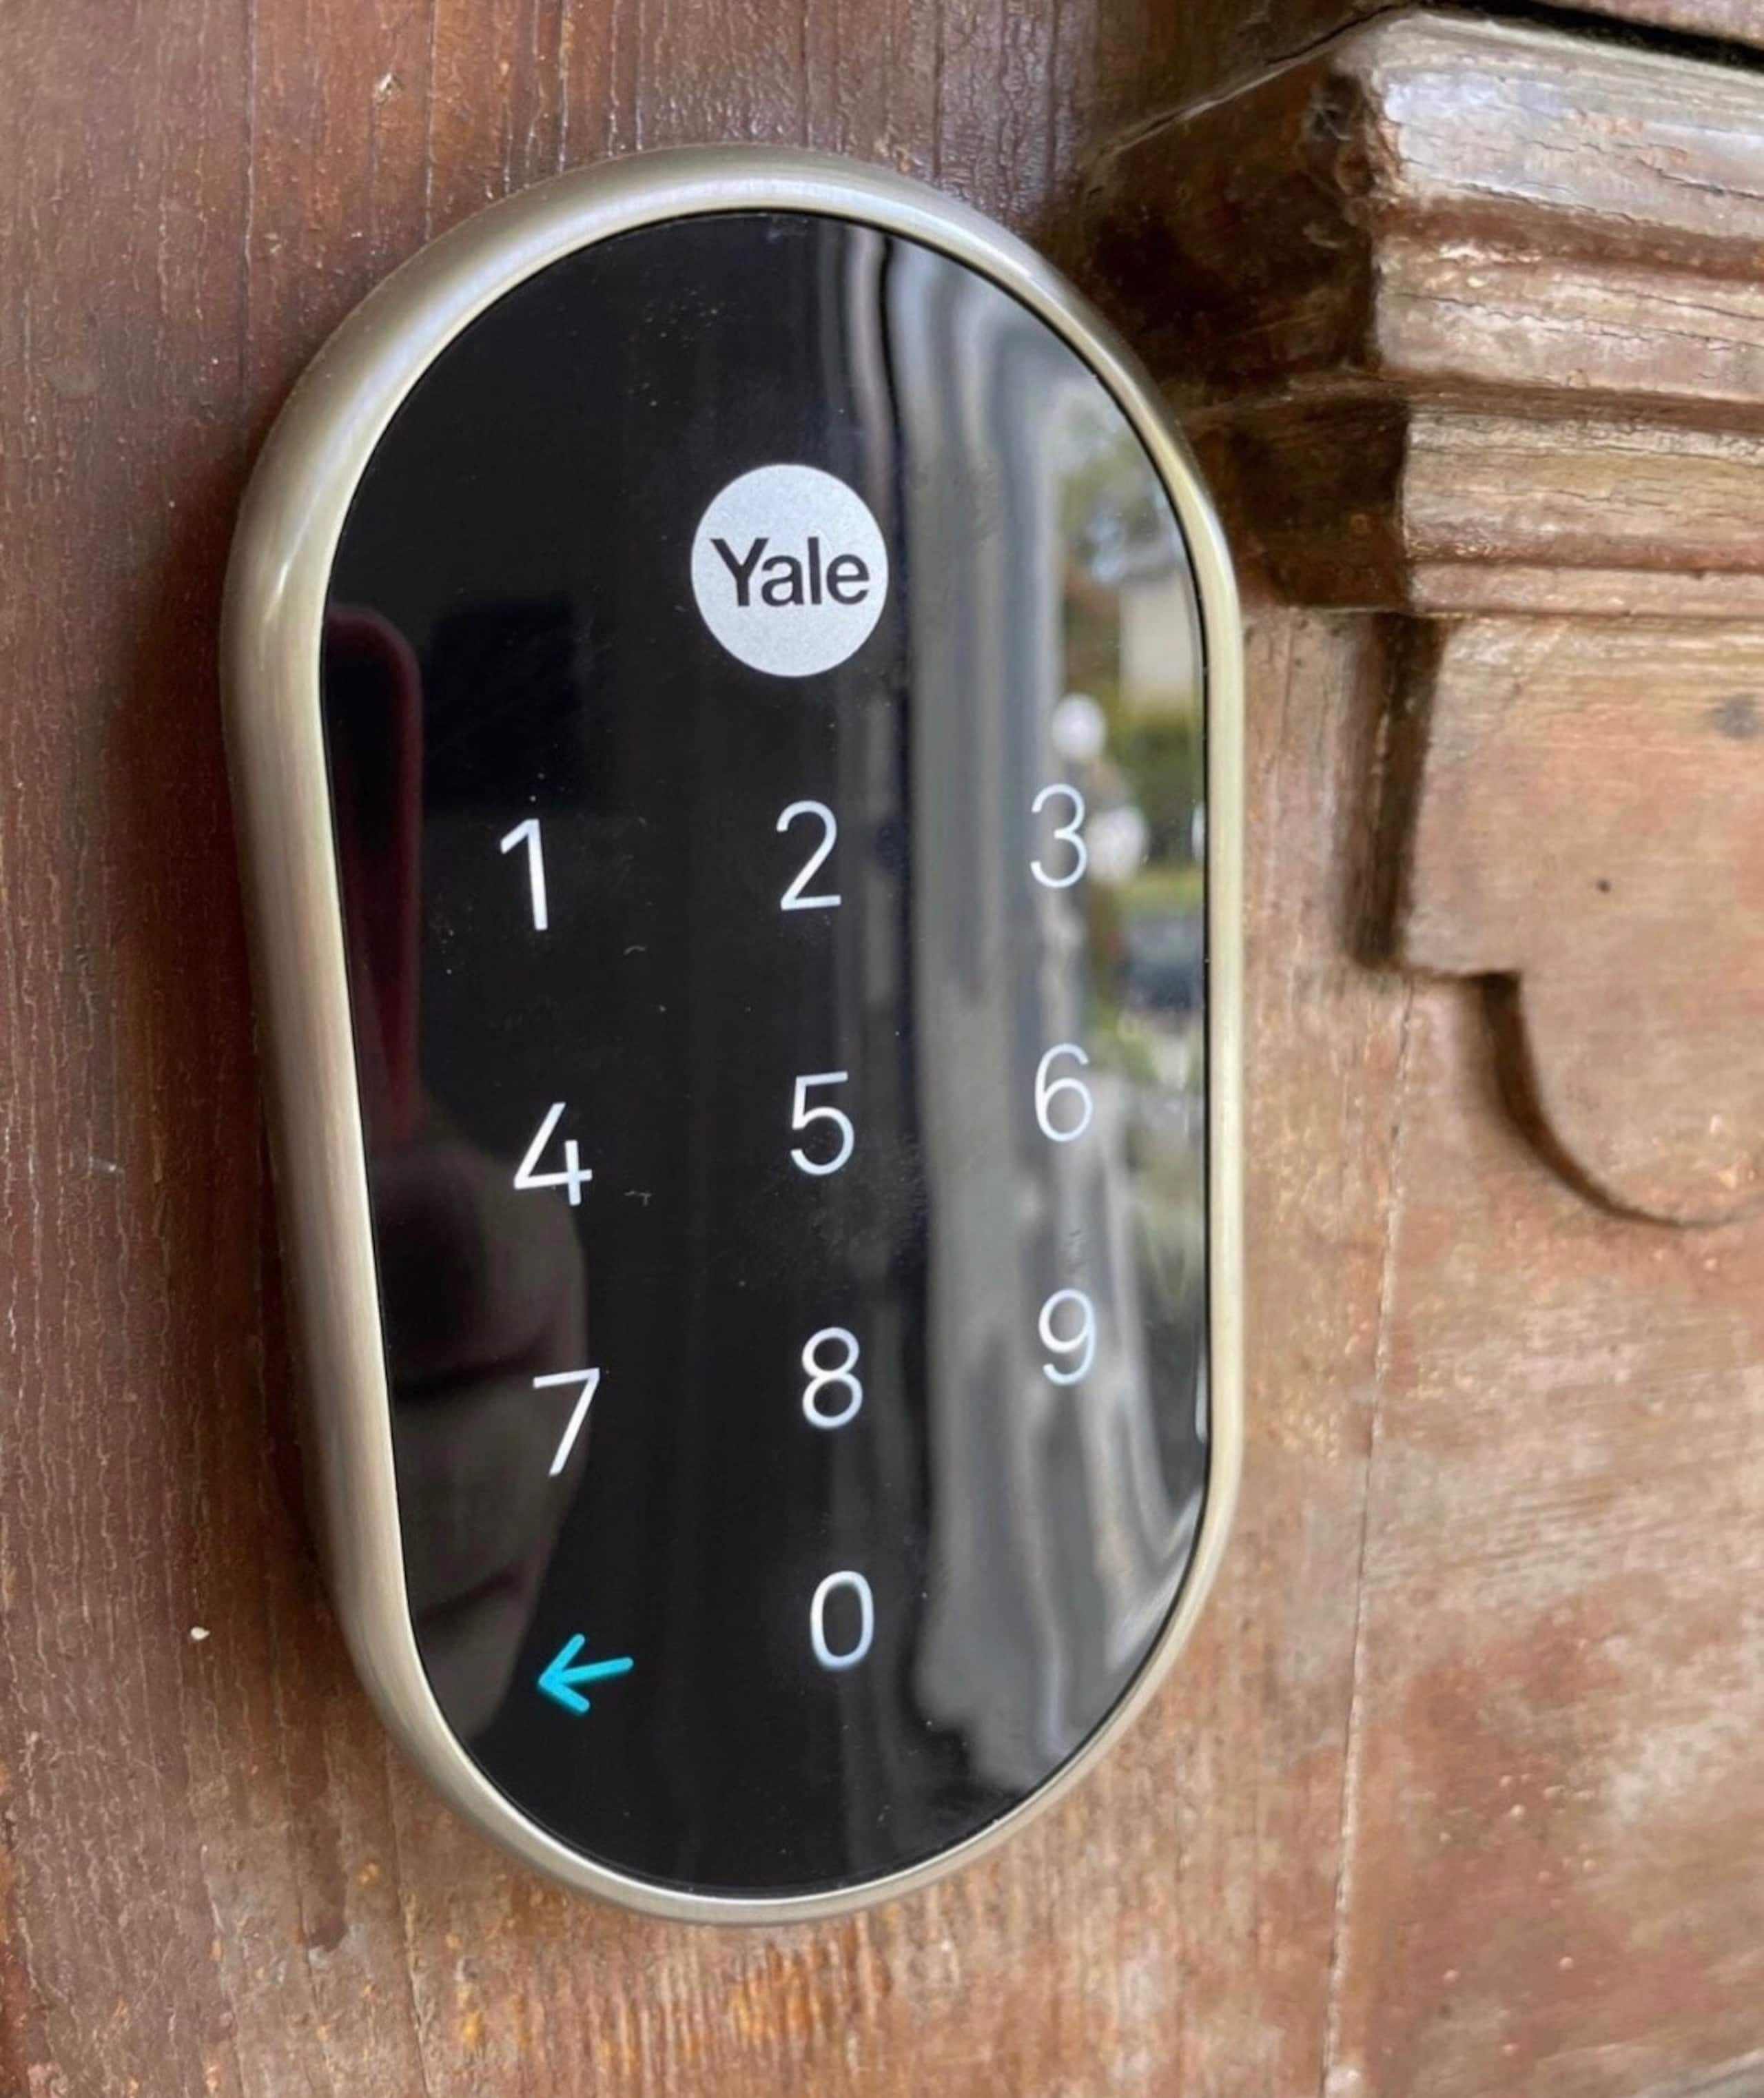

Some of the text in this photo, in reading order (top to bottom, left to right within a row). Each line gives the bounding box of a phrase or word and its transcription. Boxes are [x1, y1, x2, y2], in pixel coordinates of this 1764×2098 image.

[711, 537, 870, 606] Yale
[499, 817, 549, 932] 1
[775, 800, 842, 912] 2
[1029, 784, 1087, 889] 3
[790, 1071, 855, 1176] 5
[1034, 1043, 1092, 1142] 6
[512, 1101, 593, 1206] 4
[801, 1326, 863, 1430] 8
[1038, 1289, 1095, 1385] 9
[532, 1367, 601, 1477] 7
[809, 1570, 874, 1669] 0
